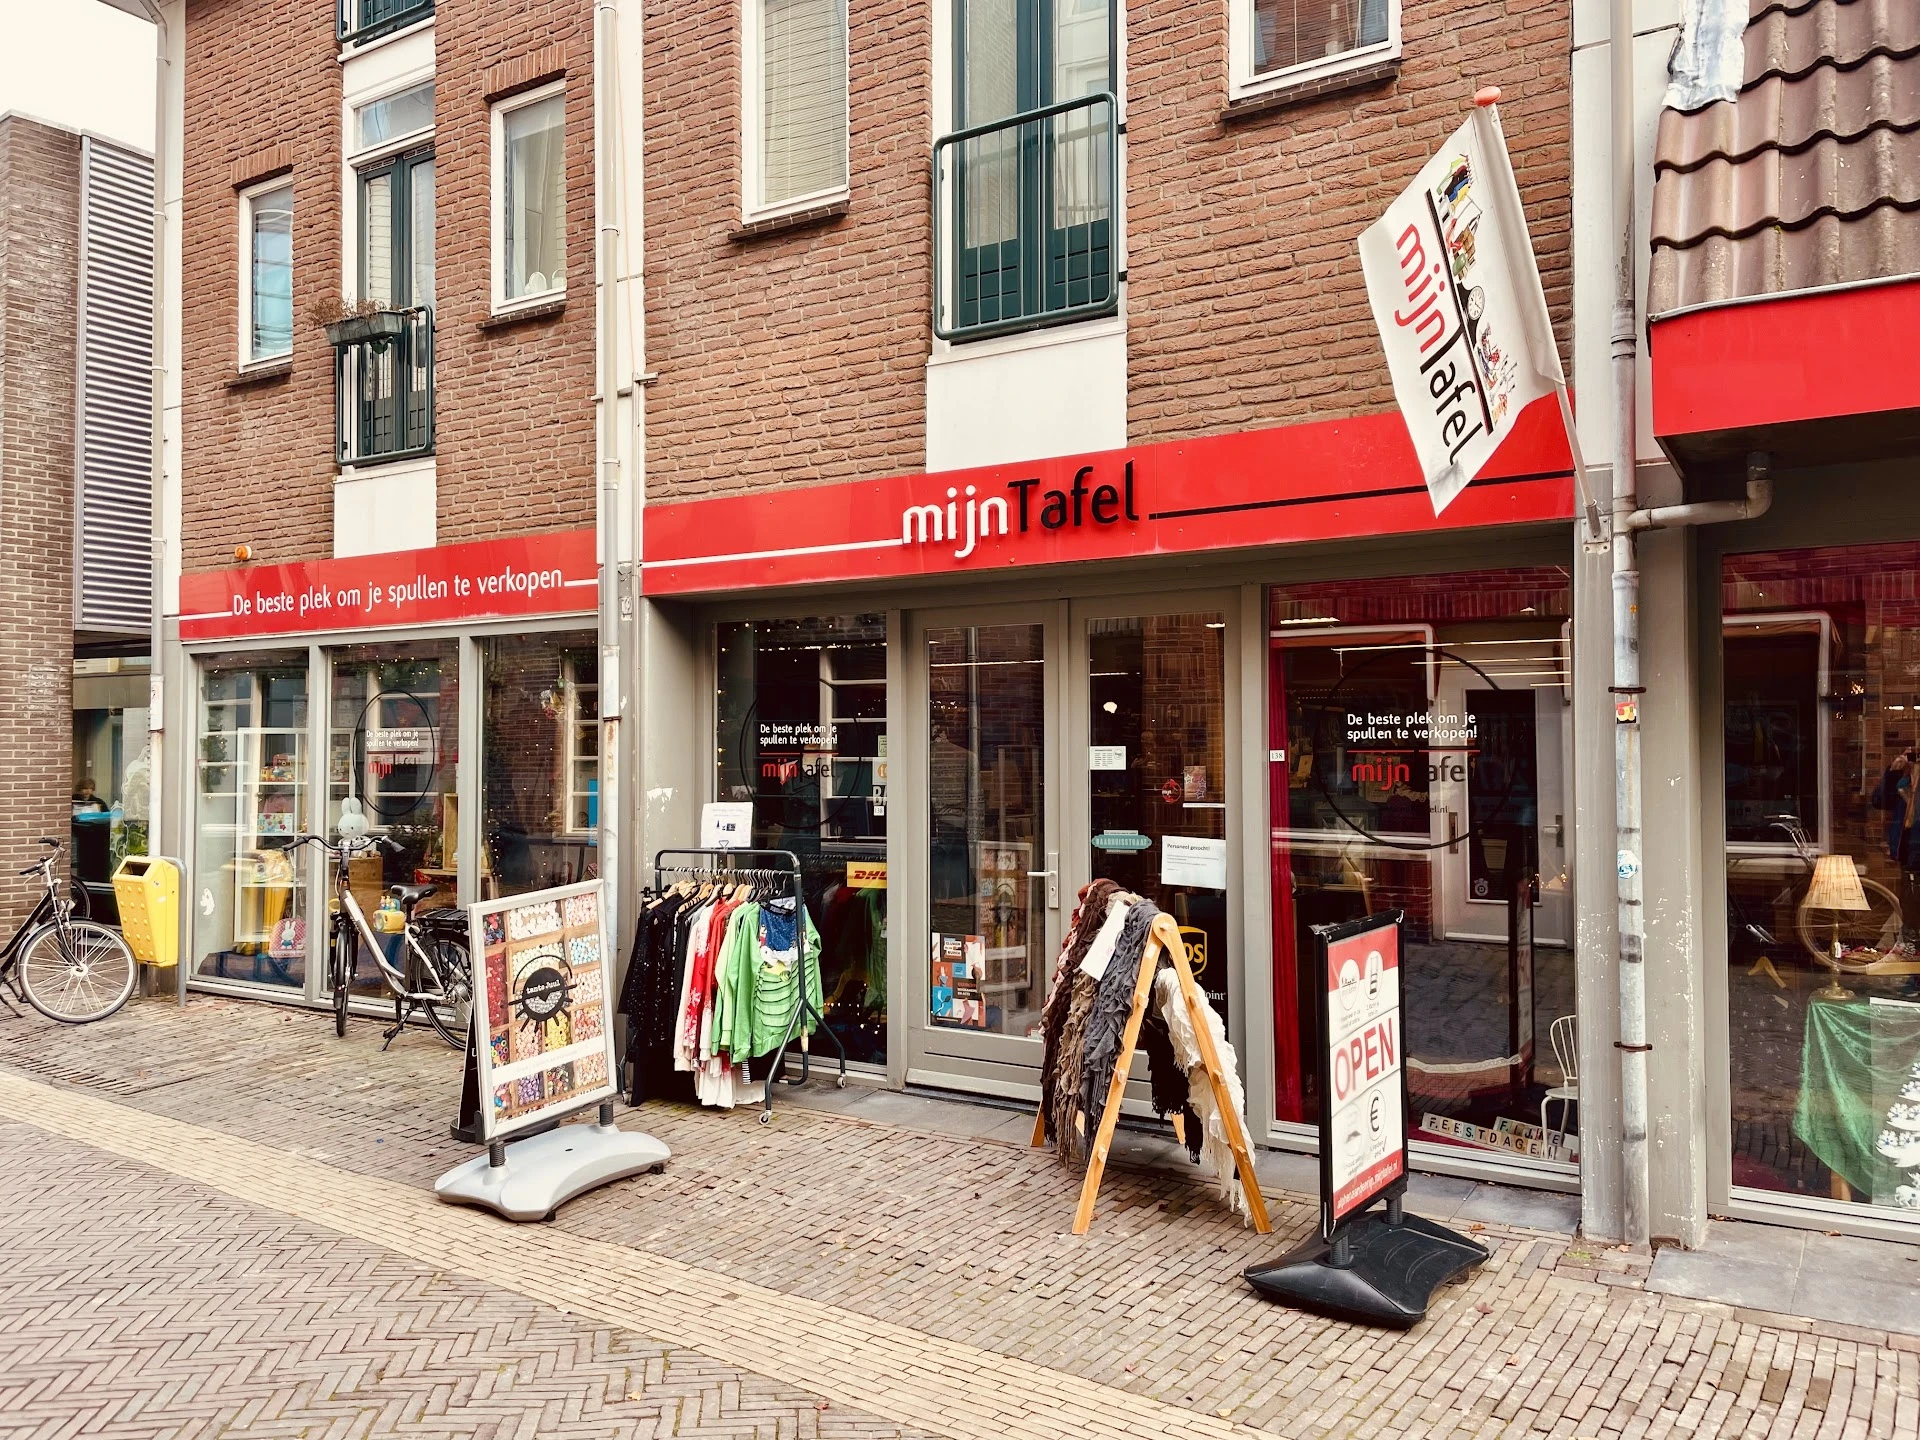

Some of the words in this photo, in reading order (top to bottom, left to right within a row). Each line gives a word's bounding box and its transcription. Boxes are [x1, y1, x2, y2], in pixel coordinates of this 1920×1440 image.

[1394, 223, 1484, 466] mijnTafel
[903, 461, 1140, 559] mijnTafel
[233, 594, 252, 616] De
[257, 590, 294, 613] beste
[300, 584, 332, 617] plek
[336, 588, 361, 607] om
[365, 581, 383, 612] je
[388, 574, 447, 610] spullen
[454, 574, 471, 597] te
[477, 566, 563, 597] verkopen
[1347, 713, 1362, 725] De
[1368, 712, 1401, 725] beste
[1406, 712, 1433, 727] plek
[1438, 714, 1458, 724] om
[1462, 712, 1476, 727] je
[366, 730, 374, 738] De
[375, 729, 389, 738] beste
[391, 729, 401, 739] plek
[412, 729, 419, 739] je
[760, 723, 770, 733] De
[773, 723, 793, 733] beste
[795, 722, 812, 735] plek
[814, 725, 826, 733] om
[829, 723, 837, 735] je
[1347, 727, 1391, 742] spullen
[1397, 728, 1409, 739] te
[1414, 725, 1478, 741] verkopen!
[366, 739, 385, 749] spullen
[387, 739, 392, 747] te
[760, 734, 787, 747] spullen
[790, 735, 798, 744] te
[800, 734, 838, 747] verkopen!
[1271, 752, 1283, 760] 138
[526, 984, 545, 994] tante
[545, 979, 561, 989] Juul
[1205, 990, 1224, 1001] oint
[1335, 1017, 1395, 1101] OPEN
